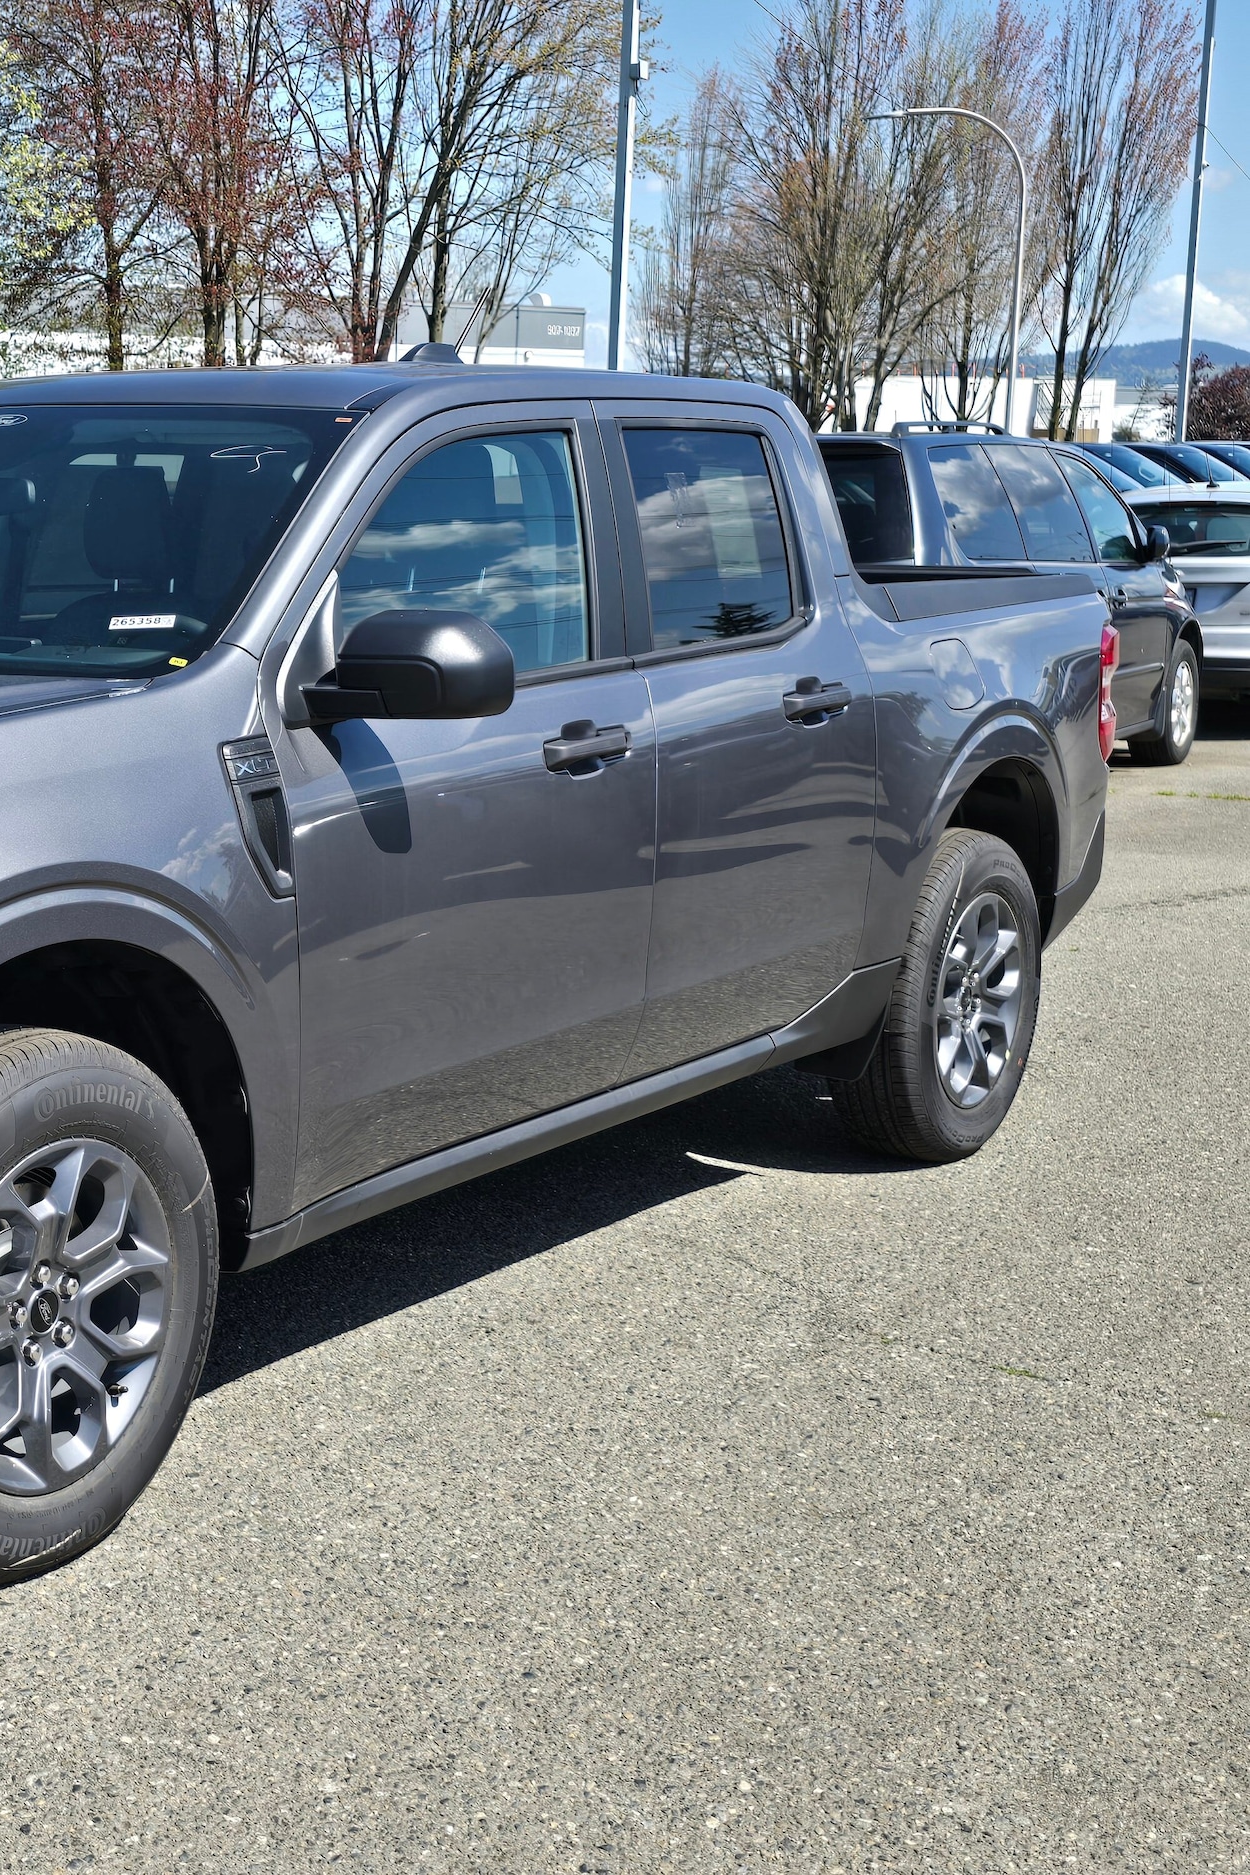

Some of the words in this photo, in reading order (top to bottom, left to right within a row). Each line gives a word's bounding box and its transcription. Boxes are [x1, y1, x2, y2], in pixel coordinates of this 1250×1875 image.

[112, 617, 161, 627] 265358
[235, 756, 275, 776] XLT
[33, 1079, 142, 1122] Continental
